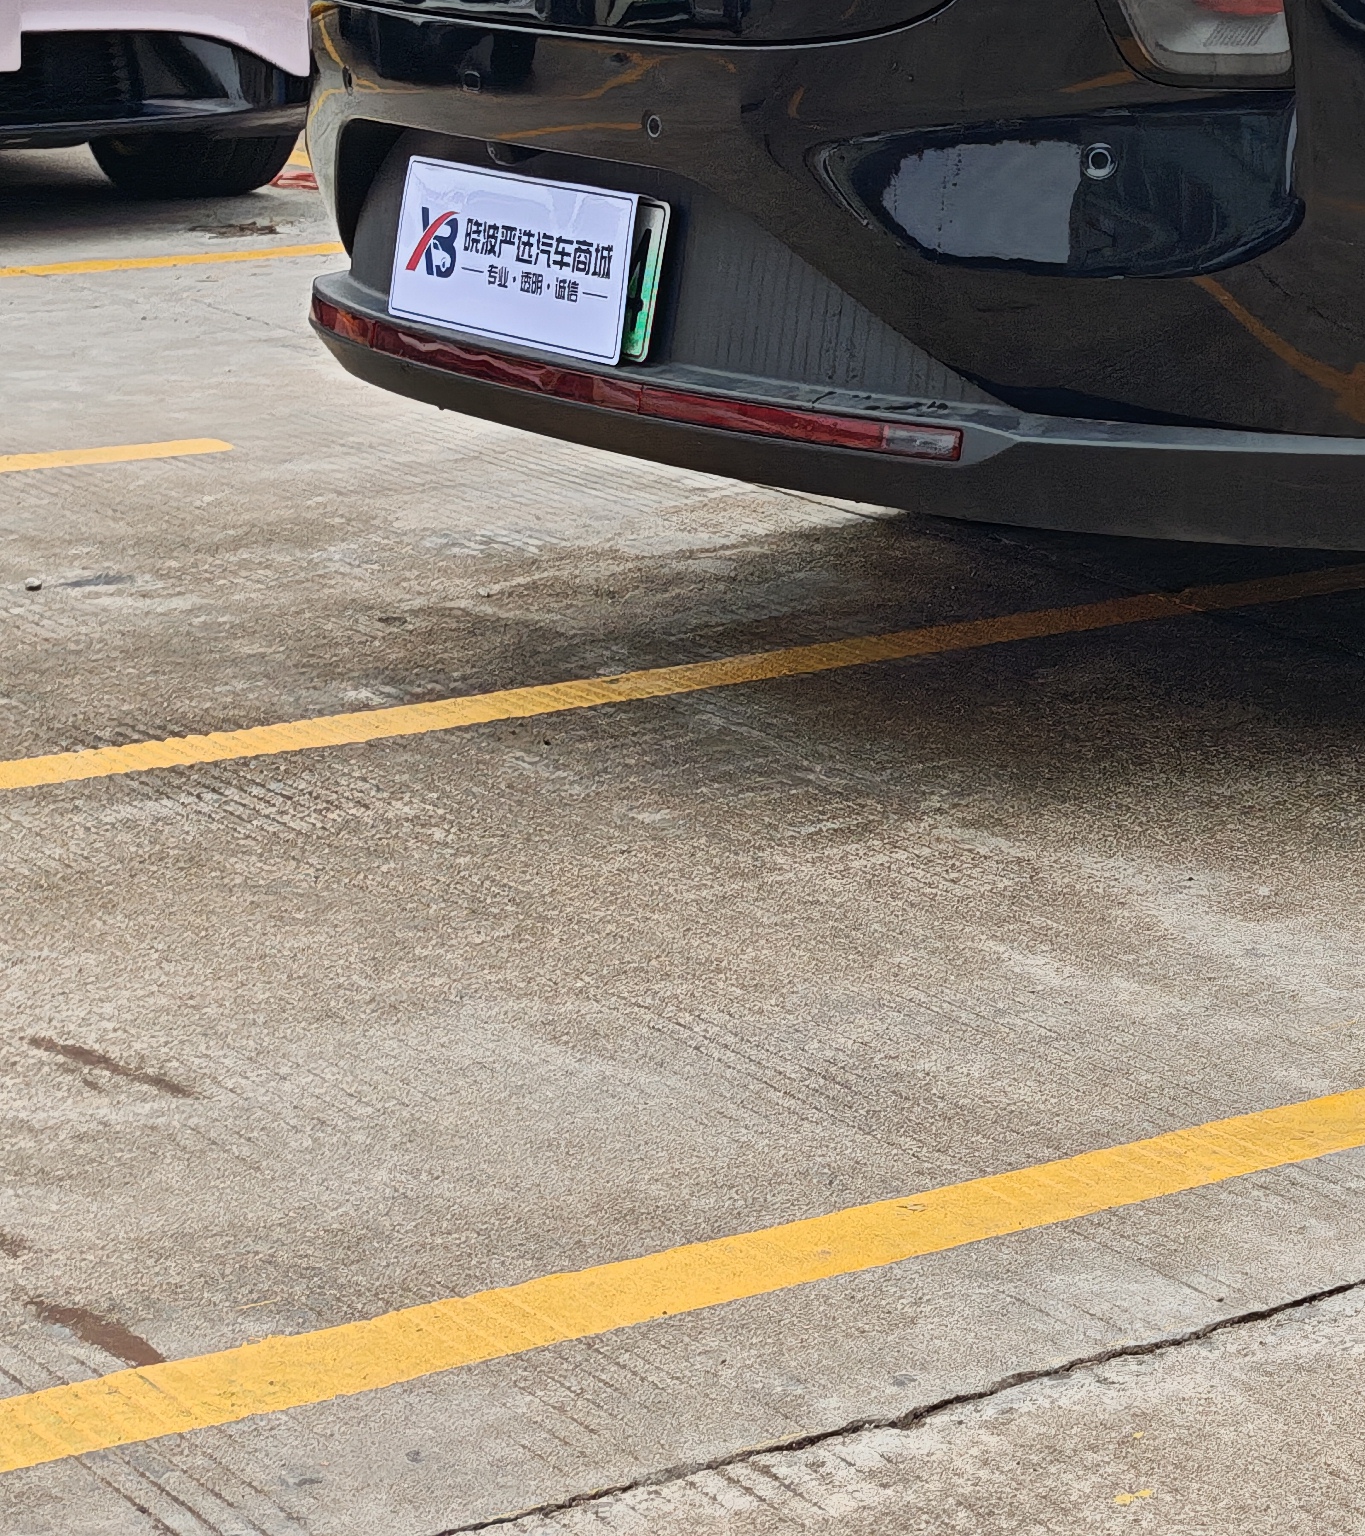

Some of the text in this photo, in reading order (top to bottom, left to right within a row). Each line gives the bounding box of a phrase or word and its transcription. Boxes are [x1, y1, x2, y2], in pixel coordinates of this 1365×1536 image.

[462, 217, 614, 280] 晓波严选汽车商城
